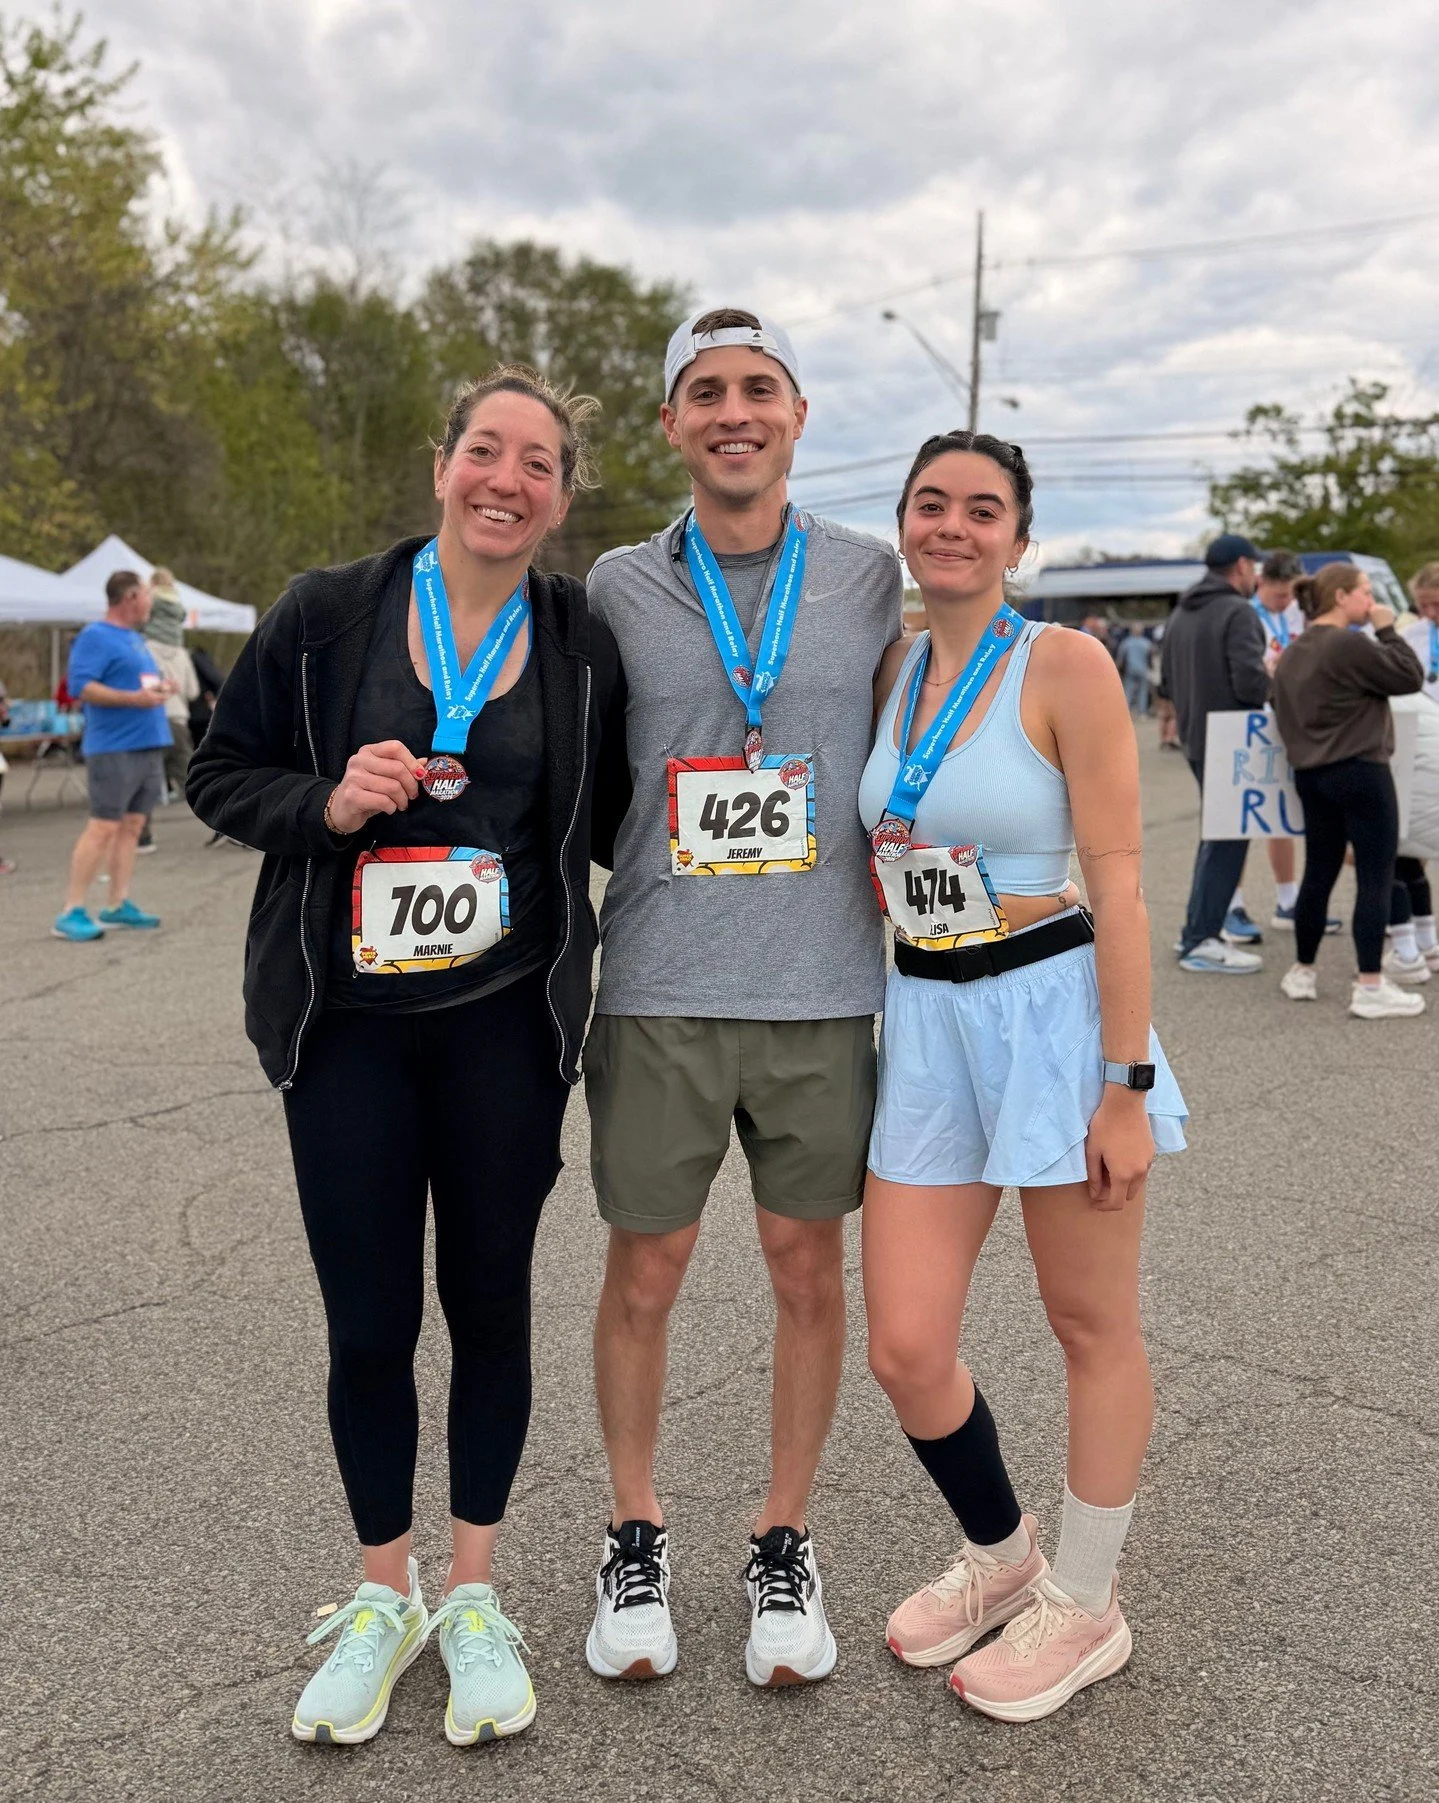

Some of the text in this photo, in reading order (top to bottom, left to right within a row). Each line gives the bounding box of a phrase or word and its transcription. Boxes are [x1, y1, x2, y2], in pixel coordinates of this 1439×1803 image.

[792, 538, 800, 558] Relay
[426, 578, 437, 615] Superhero
[691, 537, 739, 658] Superhero Half Marathon and Relay
[780, 574, 794, 609] Marathon
[433, 615, 442, 630] Half
[776, 610, 785, 626] Half
[435, 630, 447, 665] Marathon
[465, 604, 522, 701] Superhero Half Marathon and Relay
[768, 627, 781, 666] Superhero
[442, 666, 451, 679] and
[444, 680, 453, 700] Relay
[923, 643, 996, 760] Superhero Half Marathon and Relay
[789, 772, 806, 783] HALF
[1232, 747, 1294, 785] RI
[432, 780, 462, 791] HALF
[699, 790, 791, 840] 426
[727, 847, 763, 860] JEREMY
[881, 841, 906, 853] HALF
[481, 867, 499, 876] HALF
[904, 868, 966, 915] 474
[389, 883, 478, 936] 700
[413, 943, 453, 957] MARNIE
